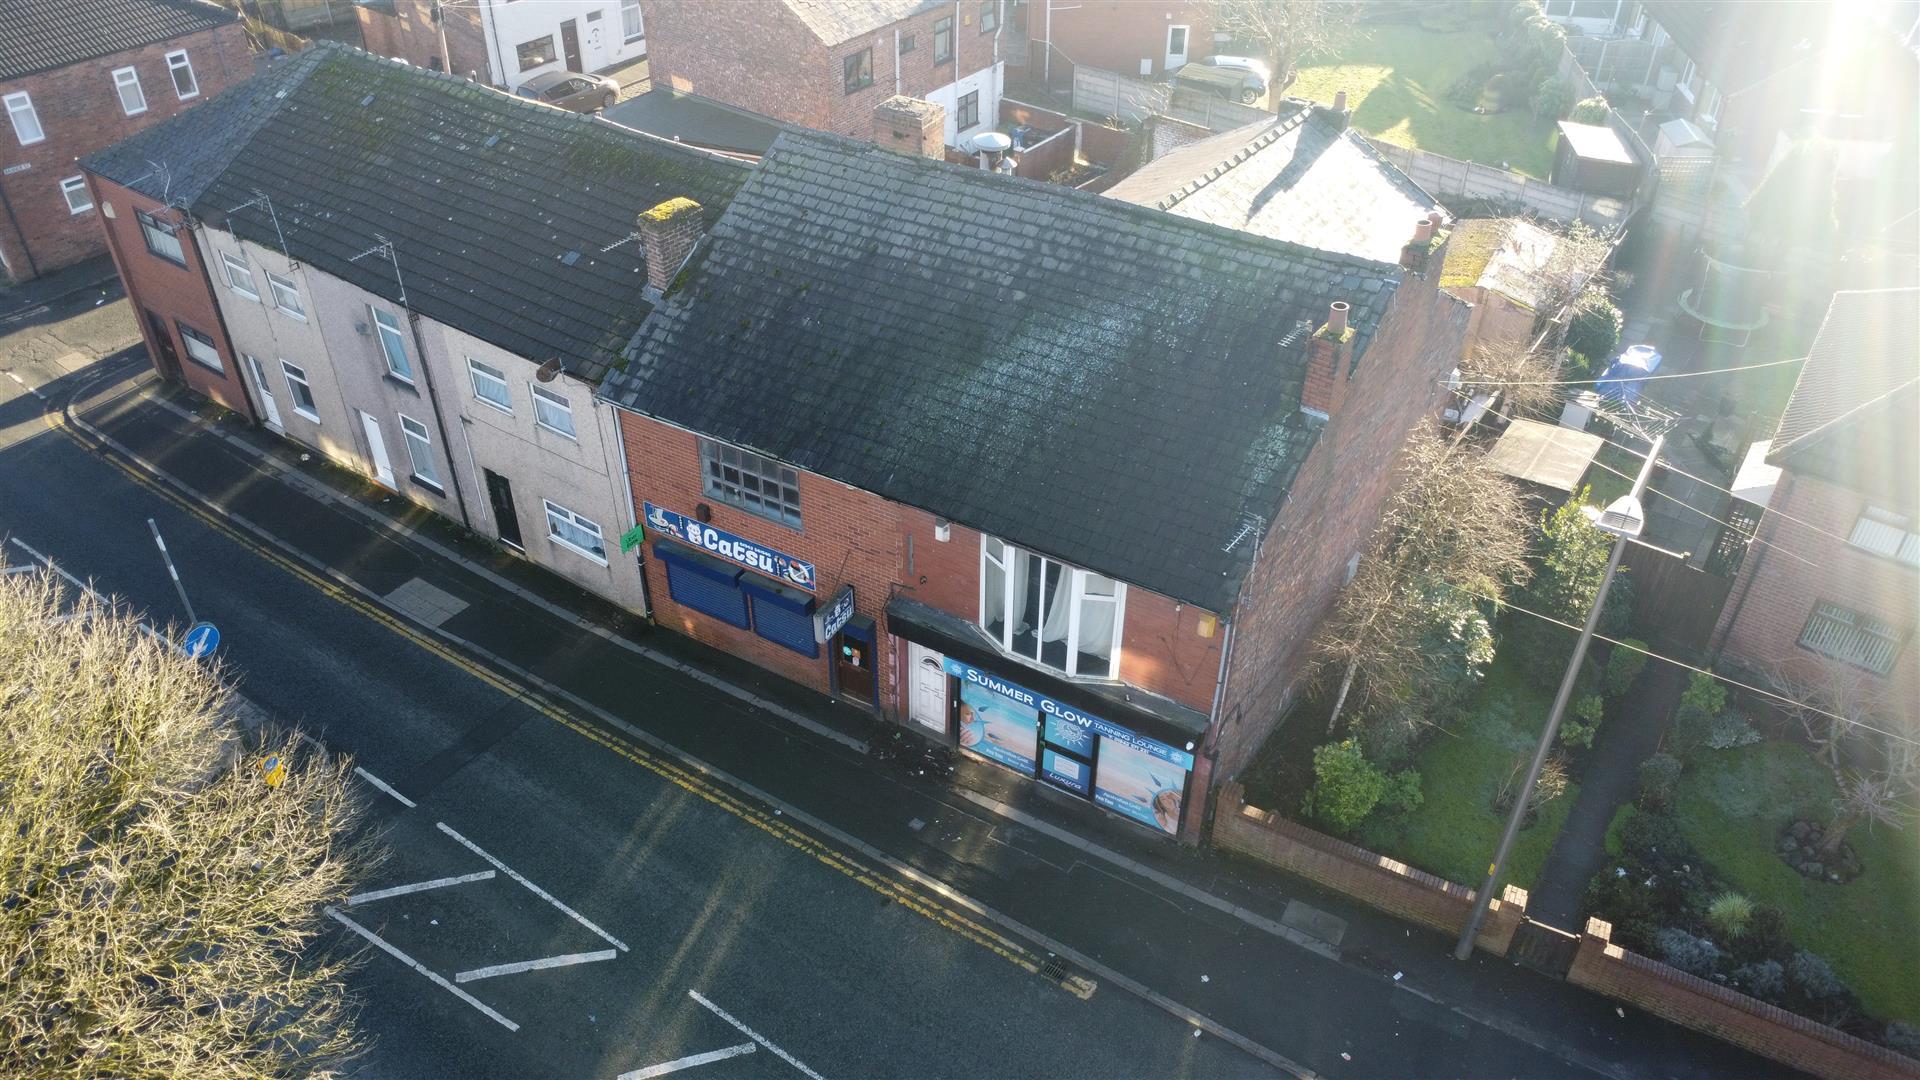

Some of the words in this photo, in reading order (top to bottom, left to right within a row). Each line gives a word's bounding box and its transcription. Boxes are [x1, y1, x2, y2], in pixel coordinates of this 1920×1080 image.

[703, 528, 774, 573] Catsu
[966, 669, 1034, 706] SUMMER
[1040, 700, 1092, 728] GLOW
[1094, 722, 1130, 741] TANNING
[1132, 735, 1168, 755] LOUNGE
[1049, 772, 1082, 790] Luxura
